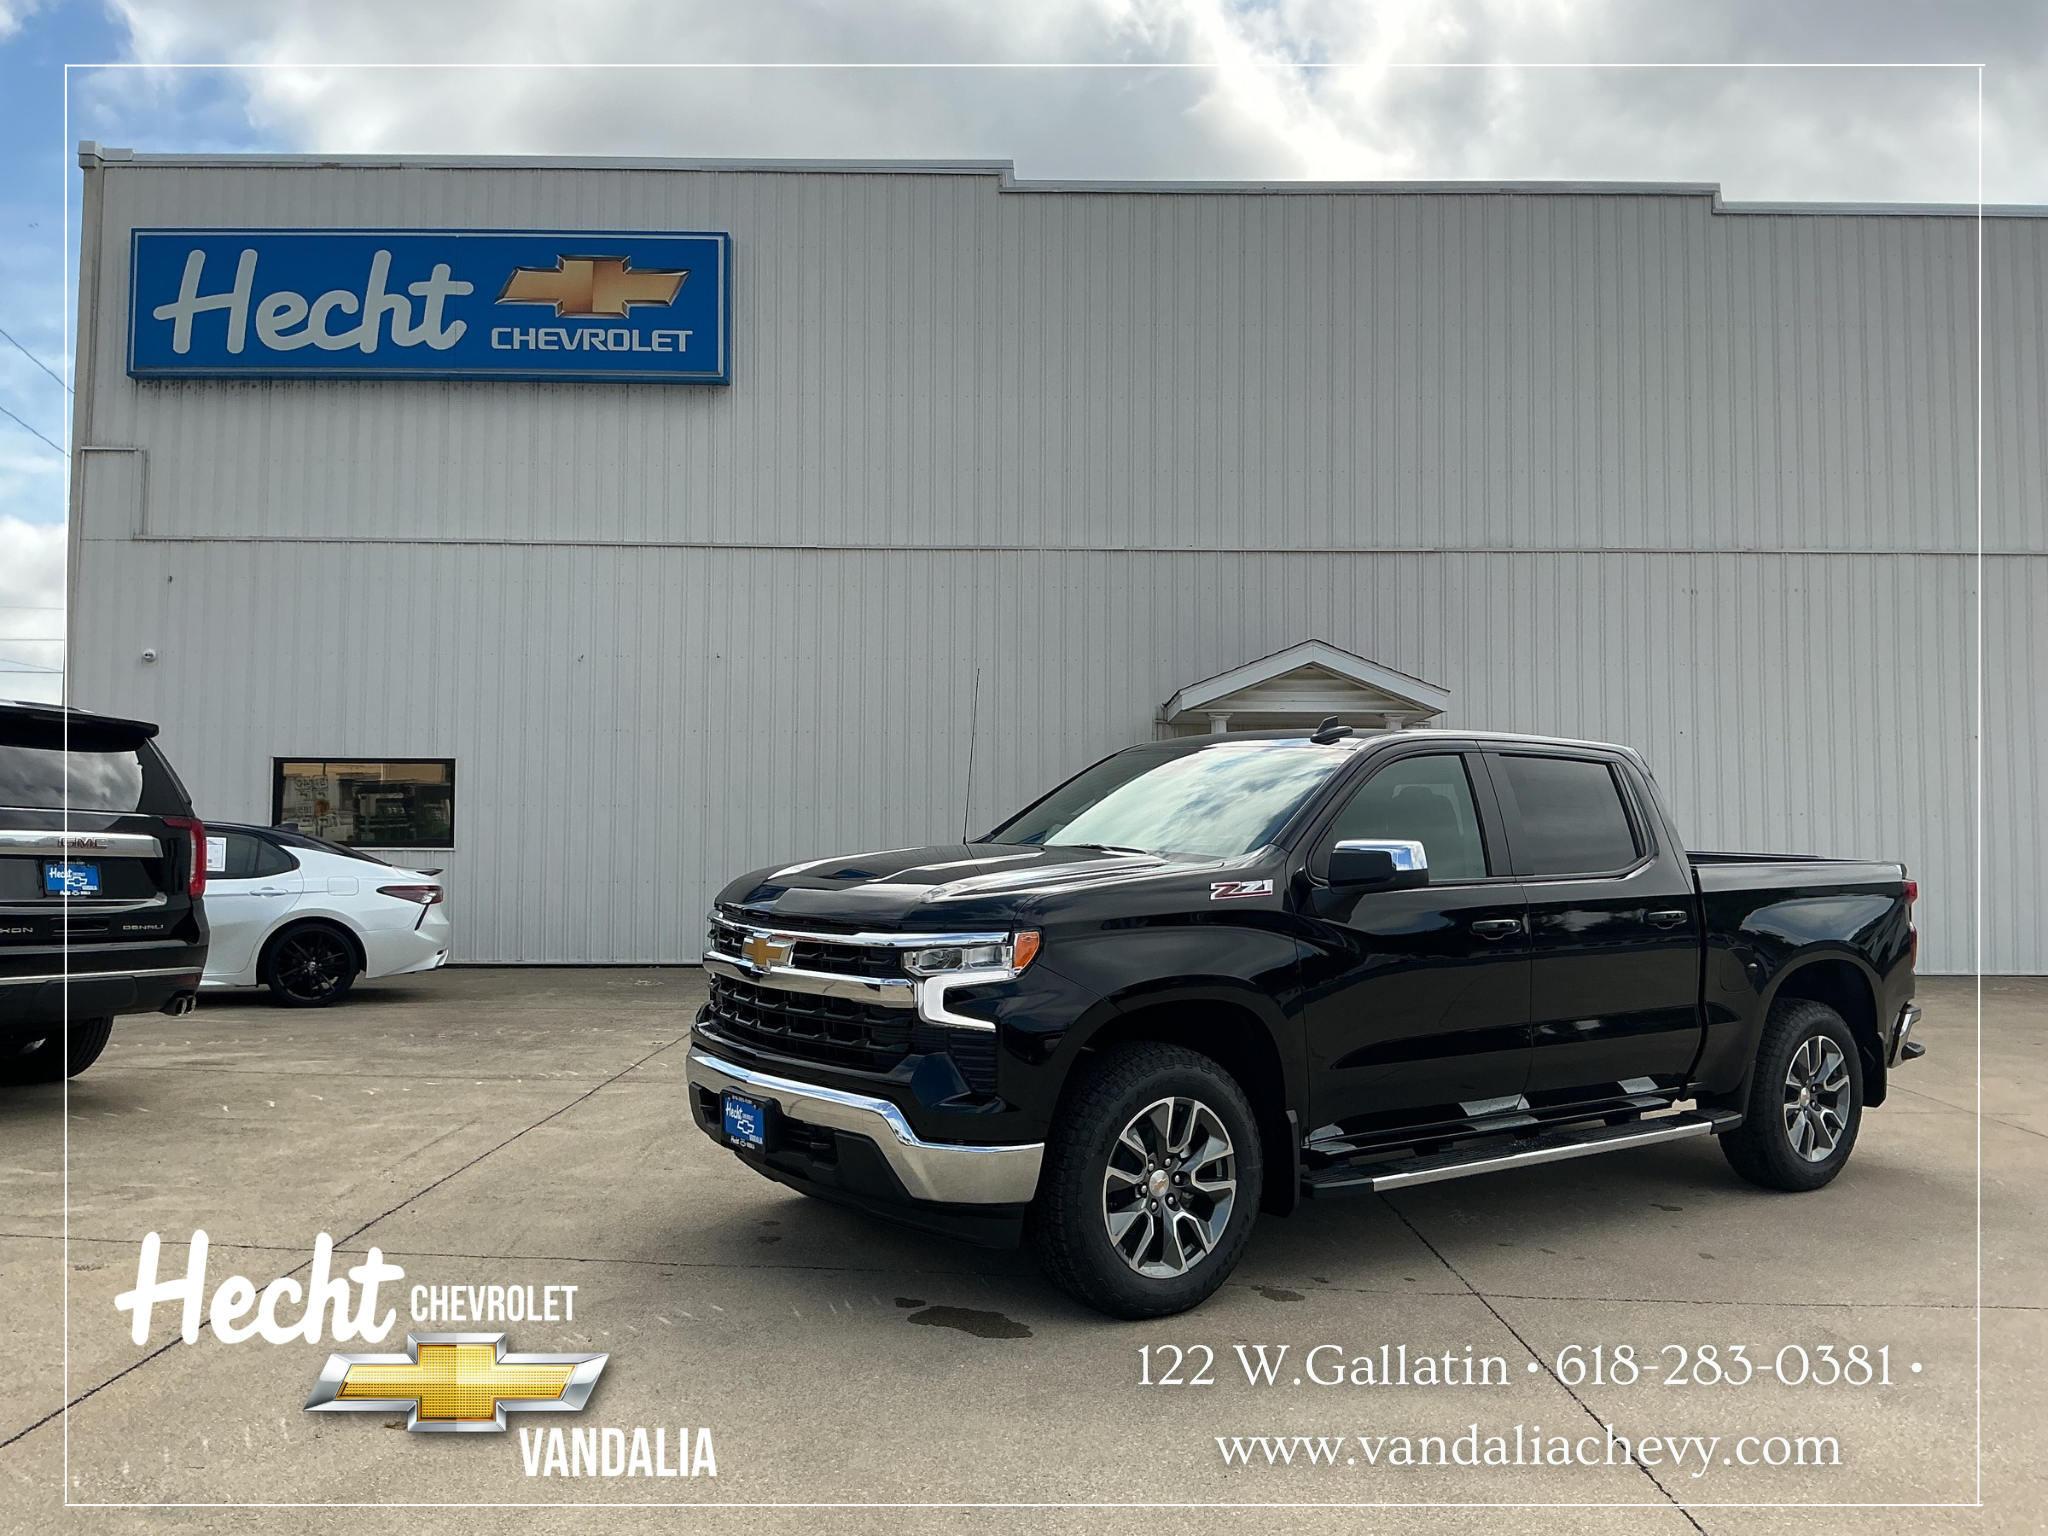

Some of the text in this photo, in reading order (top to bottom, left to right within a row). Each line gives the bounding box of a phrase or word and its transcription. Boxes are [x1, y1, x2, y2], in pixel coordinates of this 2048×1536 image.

[153, 248, 474, 354] Hecht
[491, 327, 693, 352] CHEVROLET
[58, 836, 108, 849] GMC
[1210, 879, 1273, 900] Z71
[725, 1101, 743, 1120] Hecht
